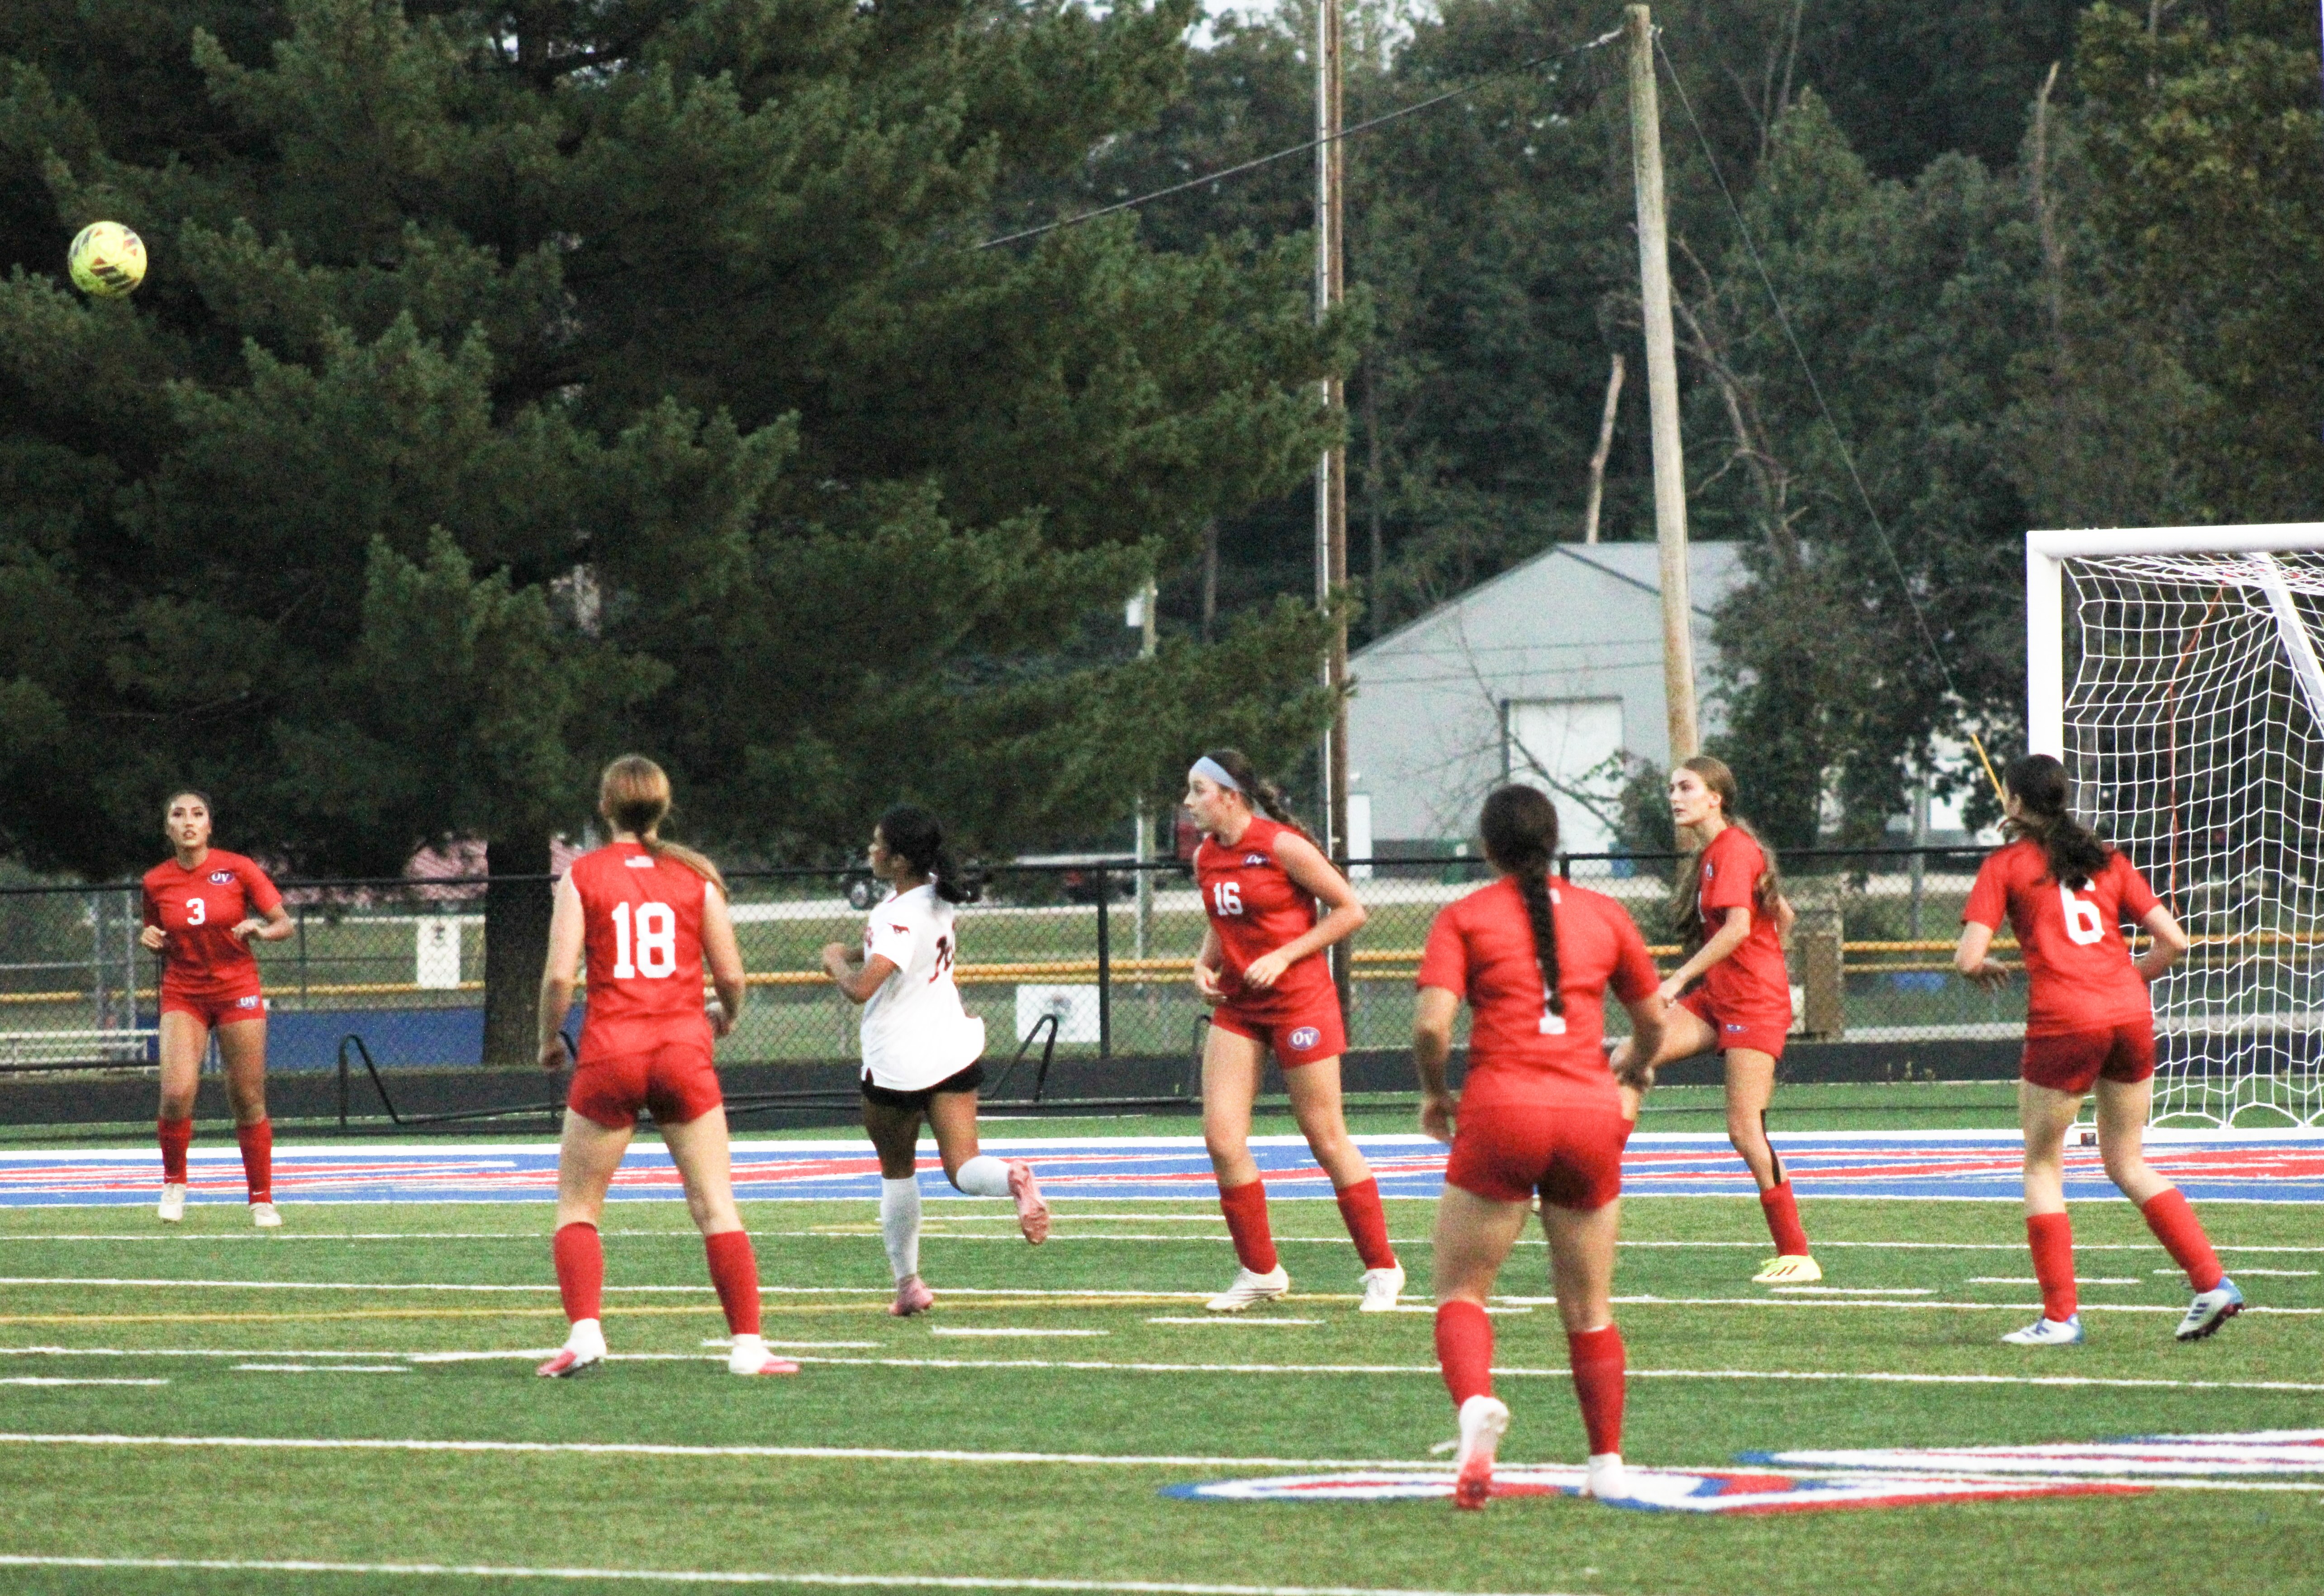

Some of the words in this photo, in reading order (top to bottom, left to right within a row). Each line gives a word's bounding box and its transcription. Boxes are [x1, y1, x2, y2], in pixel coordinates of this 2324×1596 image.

[211, 872, 230, 883] OV
[186, 898, 206, 925] 3
[1213, 882, 1243, 916] 16
[2059, 877, 2105, 945] 6
[612, 901, 677, 978] 18
[1293, 1032, 1315, 1045] OV
